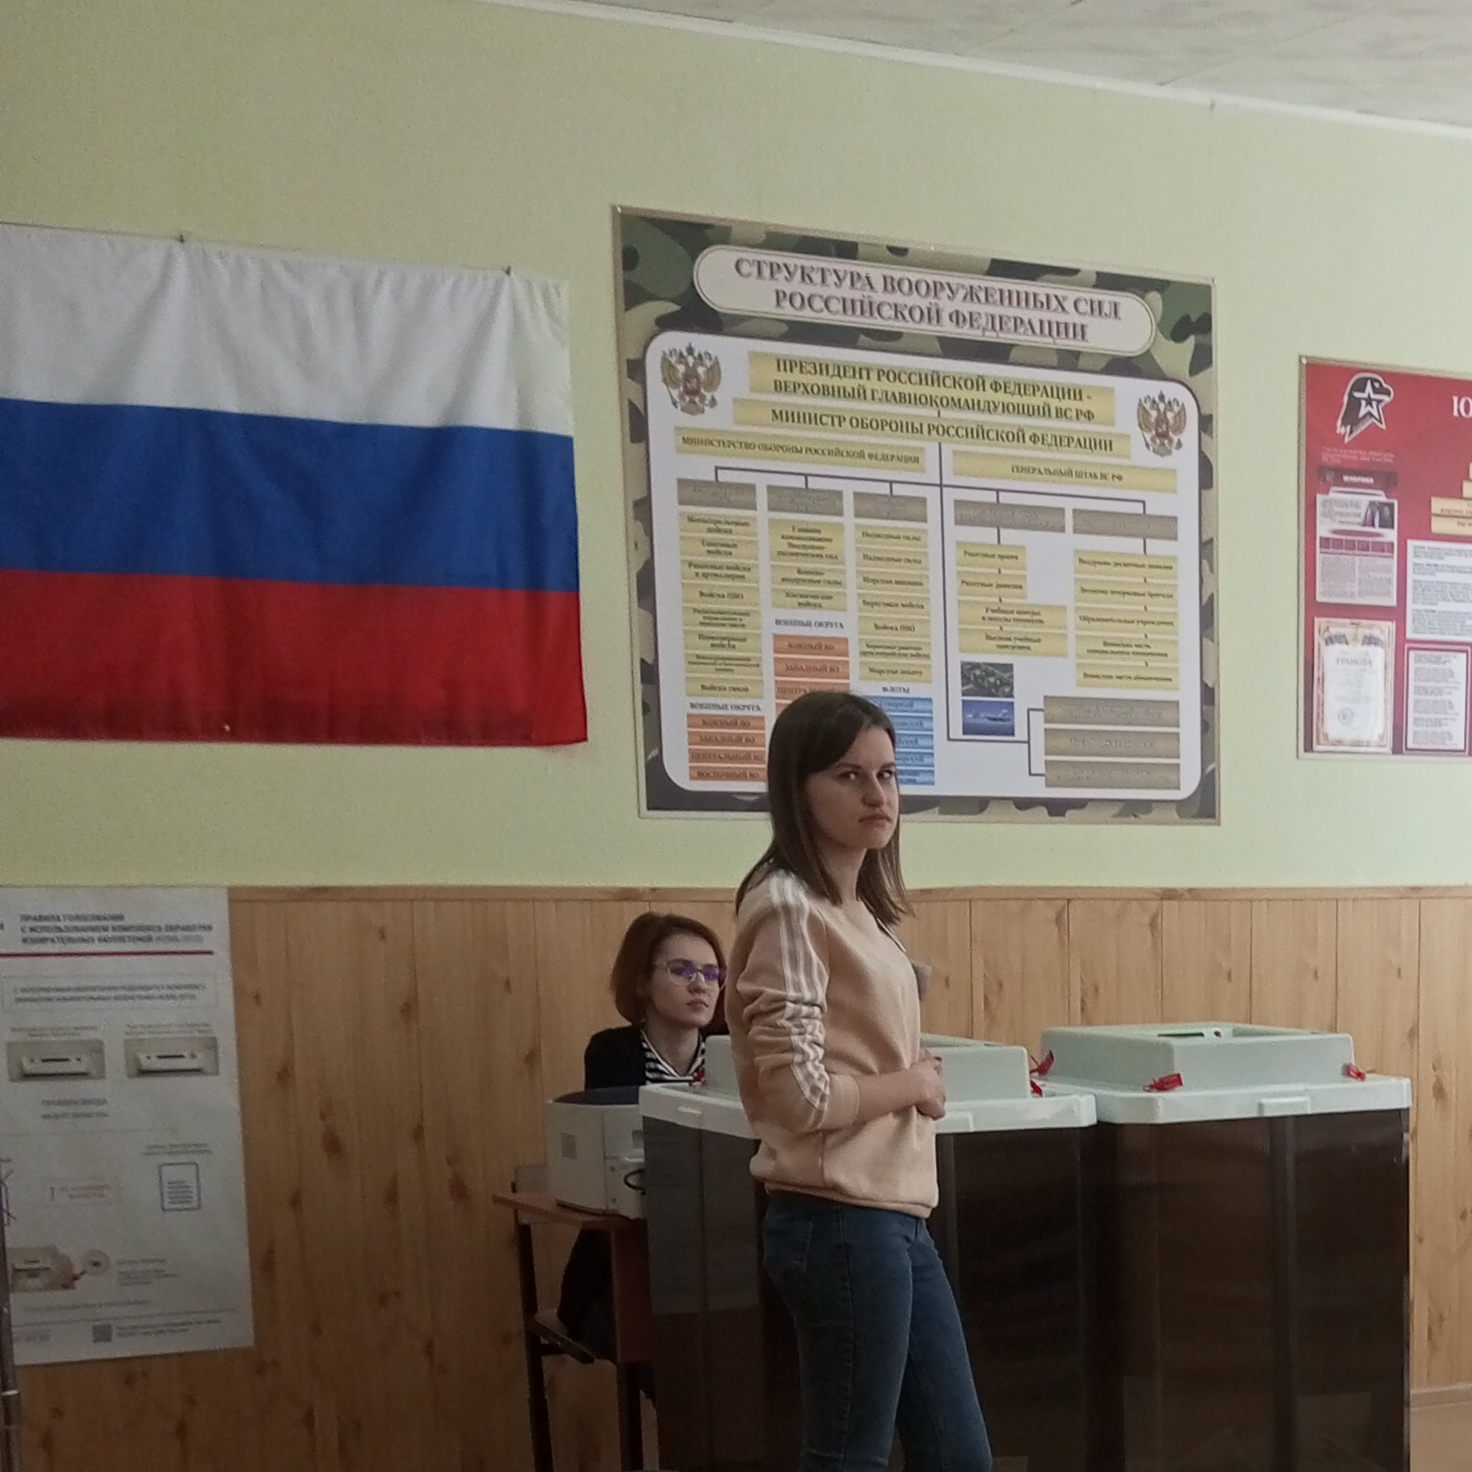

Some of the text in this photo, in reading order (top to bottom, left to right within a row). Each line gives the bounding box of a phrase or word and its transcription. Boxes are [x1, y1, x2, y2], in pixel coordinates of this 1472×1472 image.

[735, 257, 1121, 321] СТРУКТУРА ВООРУЖЕННЫХ СИЛ
[774, 288, 1089, 345] РОССИЙСКОЙ ФЕДЕРАЦИИ
[773, 379, 1095, 423] ВЕРХОВНЫЙ ГЛАВНОКОМАНДУЮЩИЙ ВС РФ
[776, 358, 873, 381] ПРЕЗИДЕНТ
[876, 368, 986, 392] РОССИЙСКОЙ
[990, 380, 1083, 402] ФЕДЕРАЦИИ
[771, 409, 1114, 453] МИНИСТР ОБОРОНЫ РОССИЙСКОЙ ФЕДЕРАЦИИ
